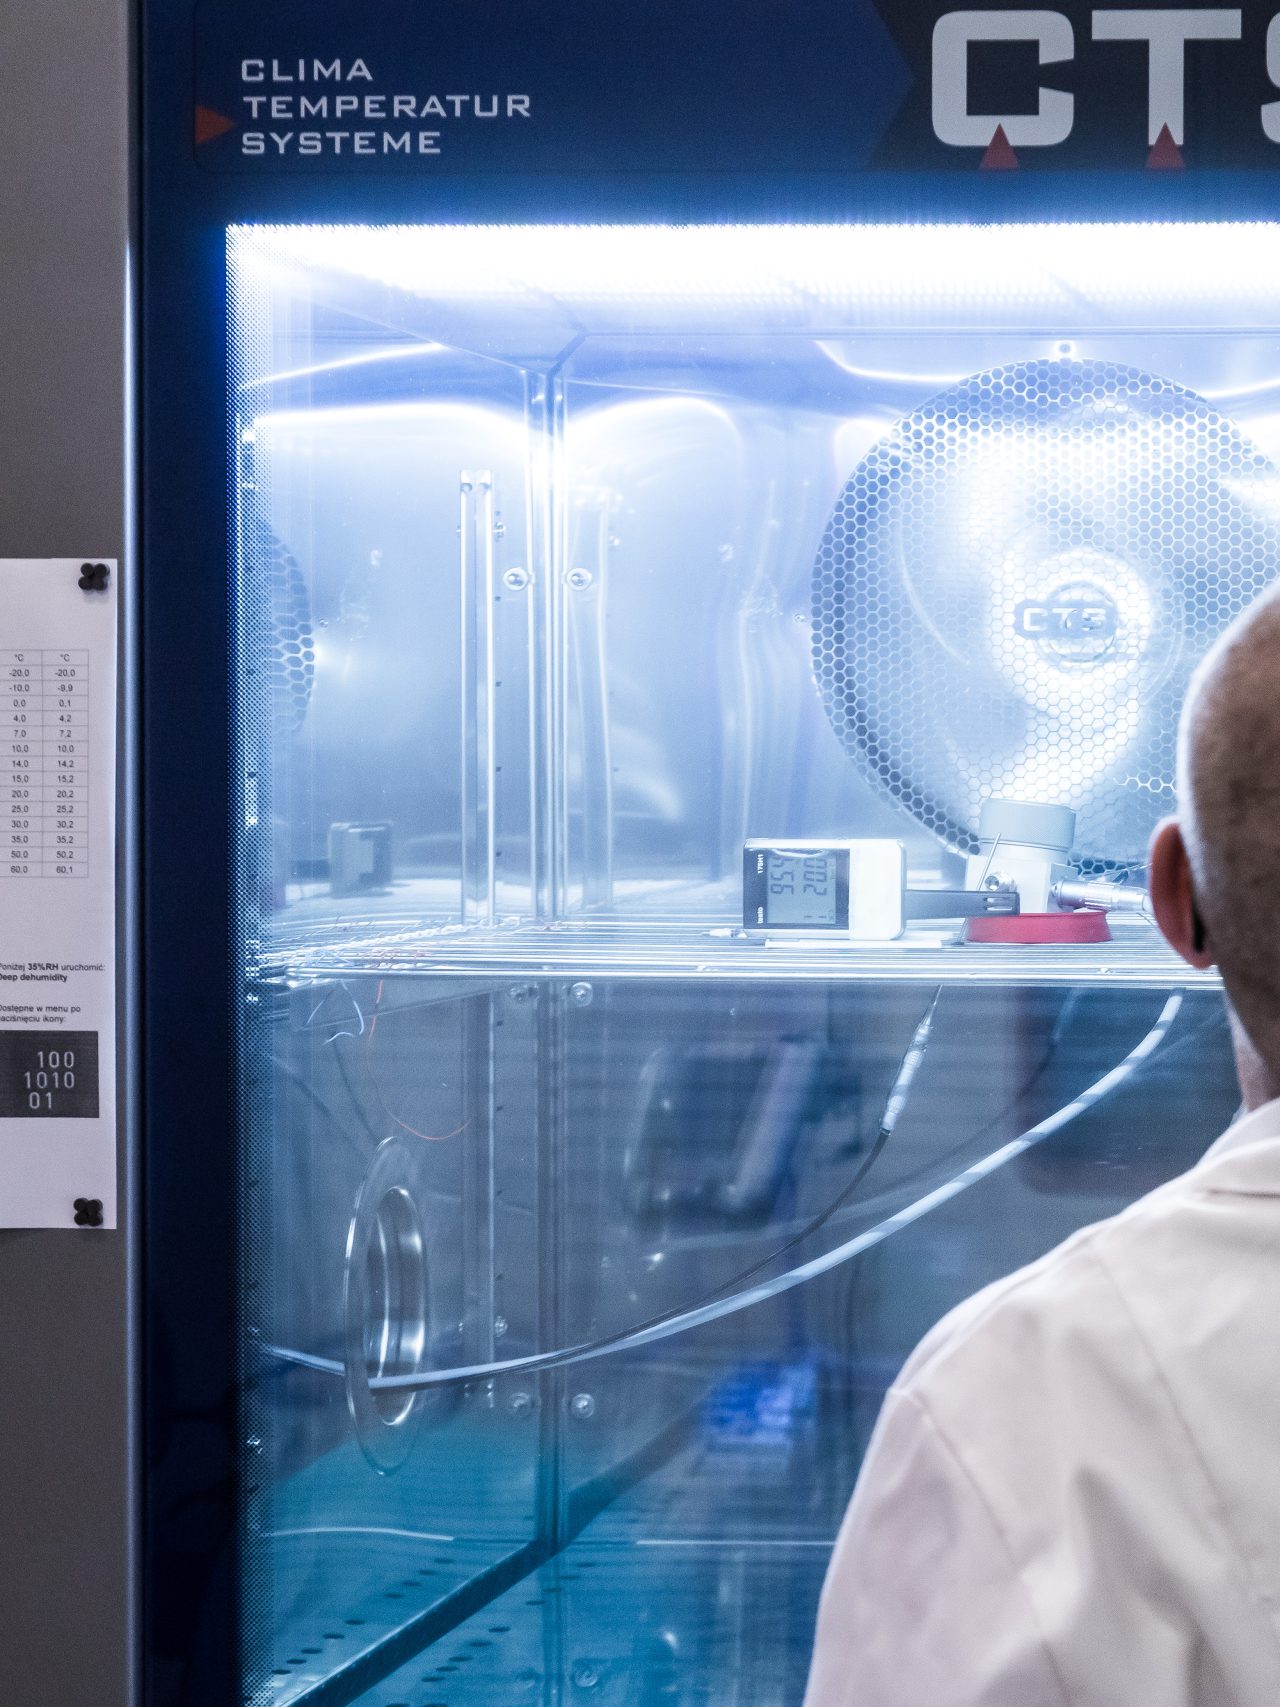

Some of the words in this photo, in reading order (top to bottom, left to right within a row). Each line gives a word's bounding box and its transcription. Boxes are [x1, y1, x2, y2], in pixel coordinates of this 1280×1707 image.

[241, 58, 373, 82] CLIMA
[243, 94, 531, 119] TEMPERATUR
[241, 131, 441, 154] SYSTEME
[20, 973, 68, 982] dehumidity
[70, 1006, 81, 1014] po
